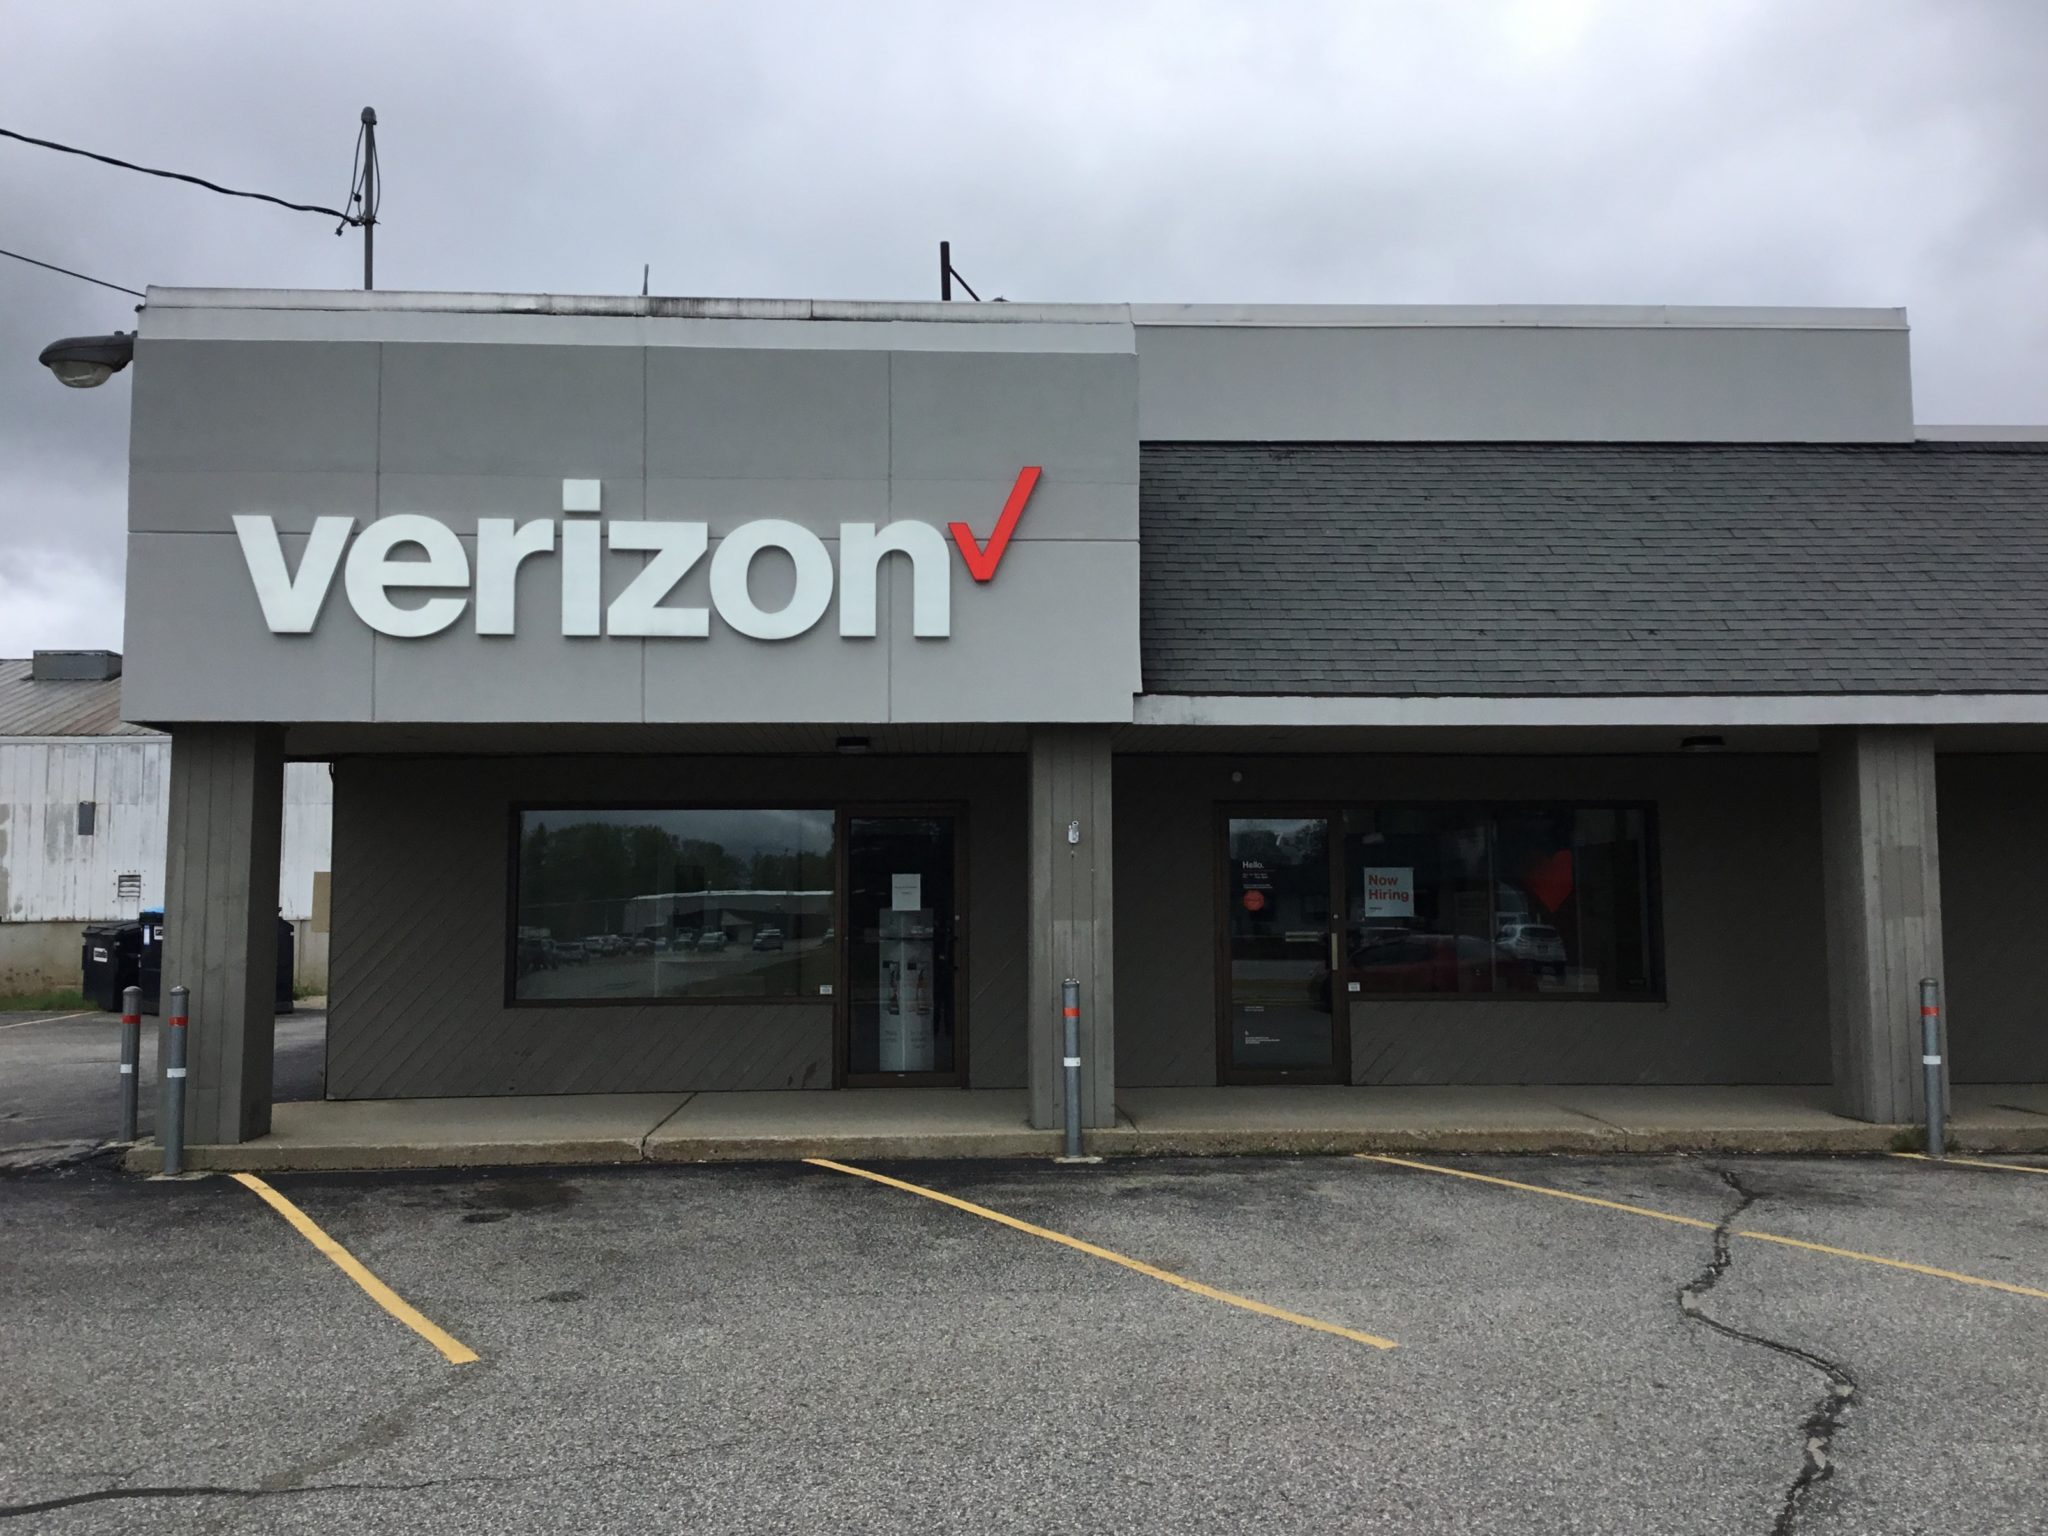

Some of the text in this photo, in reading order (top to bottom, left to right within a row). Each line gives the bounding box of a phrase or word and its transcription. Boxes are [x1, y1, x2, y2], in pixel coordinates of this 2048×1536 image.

[232, 479, 951, 640] verizon
[1368, 874, 1398, 886] Now
[1368, 889, 1410, 903] Hiring
